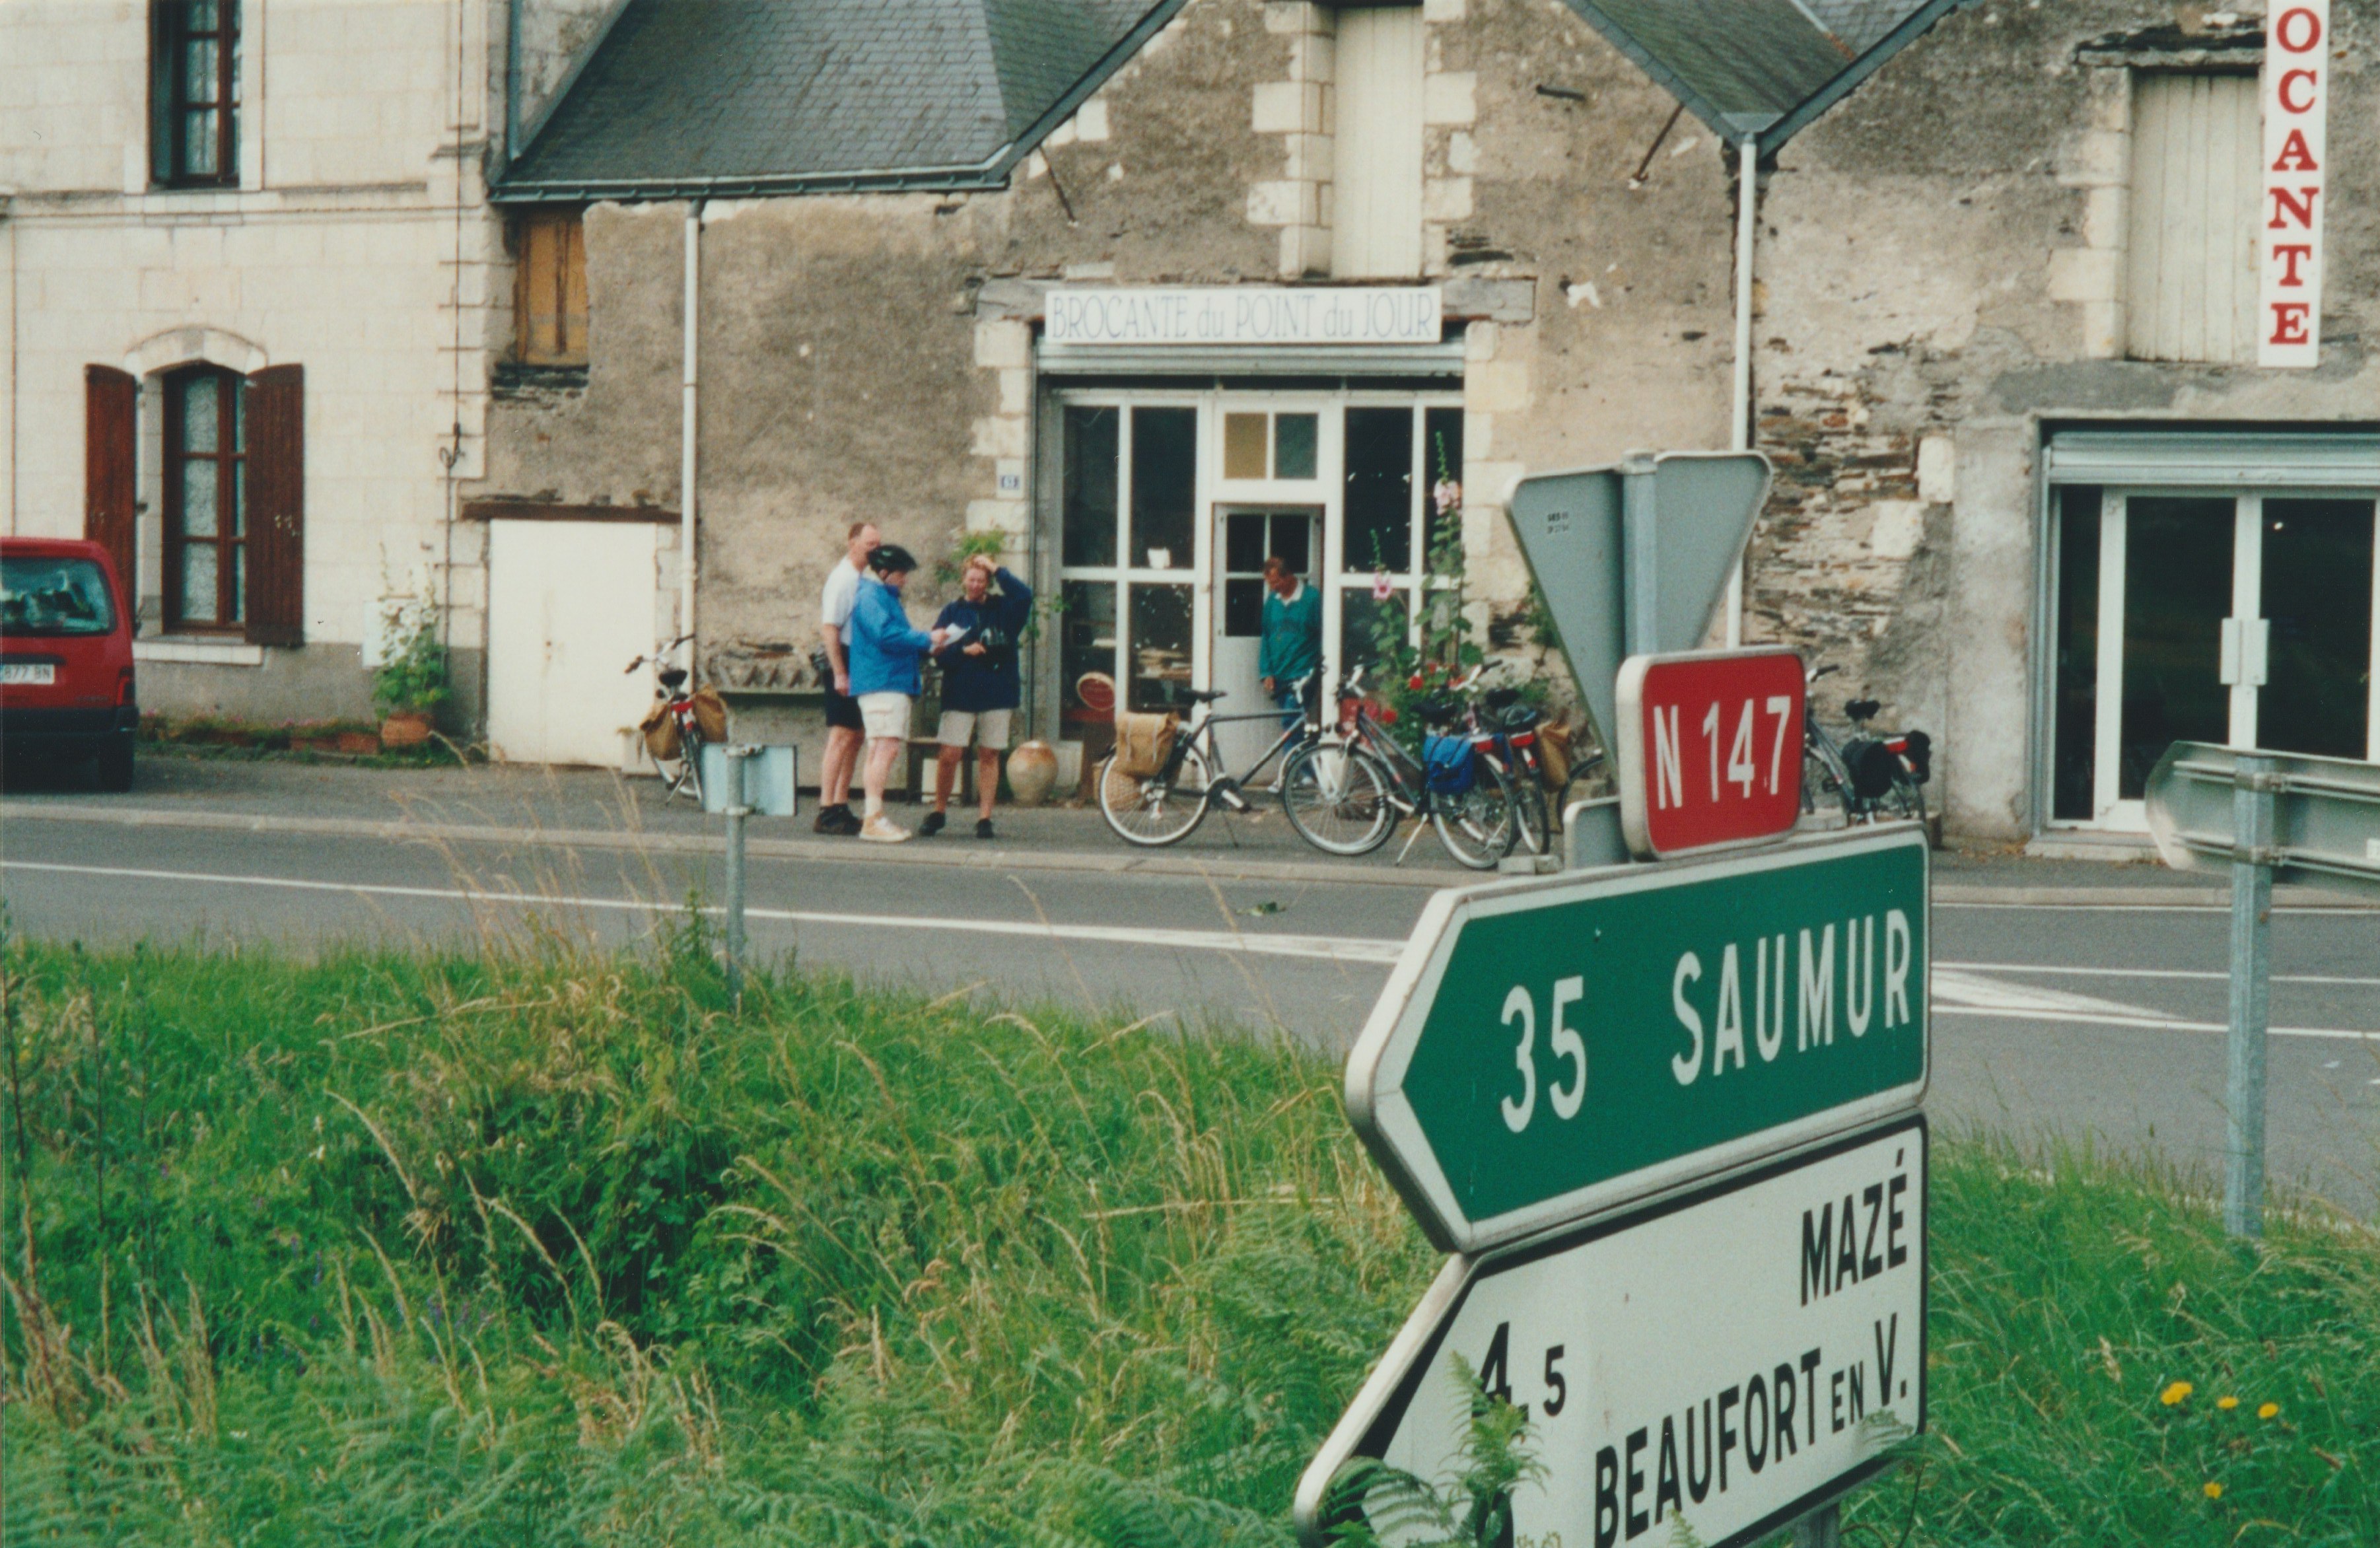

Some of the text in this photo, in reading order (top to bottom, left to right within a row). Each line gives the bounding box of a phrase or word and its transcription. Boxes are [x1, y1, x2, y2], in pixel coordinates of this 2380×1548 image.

[2268, 7, 2321, 345] OCANTE
[1052, 292, 1433, 339] BROCANTE du POINT du JOUR
[1652, 695, 1792, 810] N 147
[1500, 908, 1911, 1134] 35 SAUMUR
[1800, 1147, 1908, 1307] MAZÉ
[1594, 1347, 1821, 1548] BEAUFORT
[1831, 1360, 1864, 1434] EN
[1874, 1312, 1907, 1407] V.
